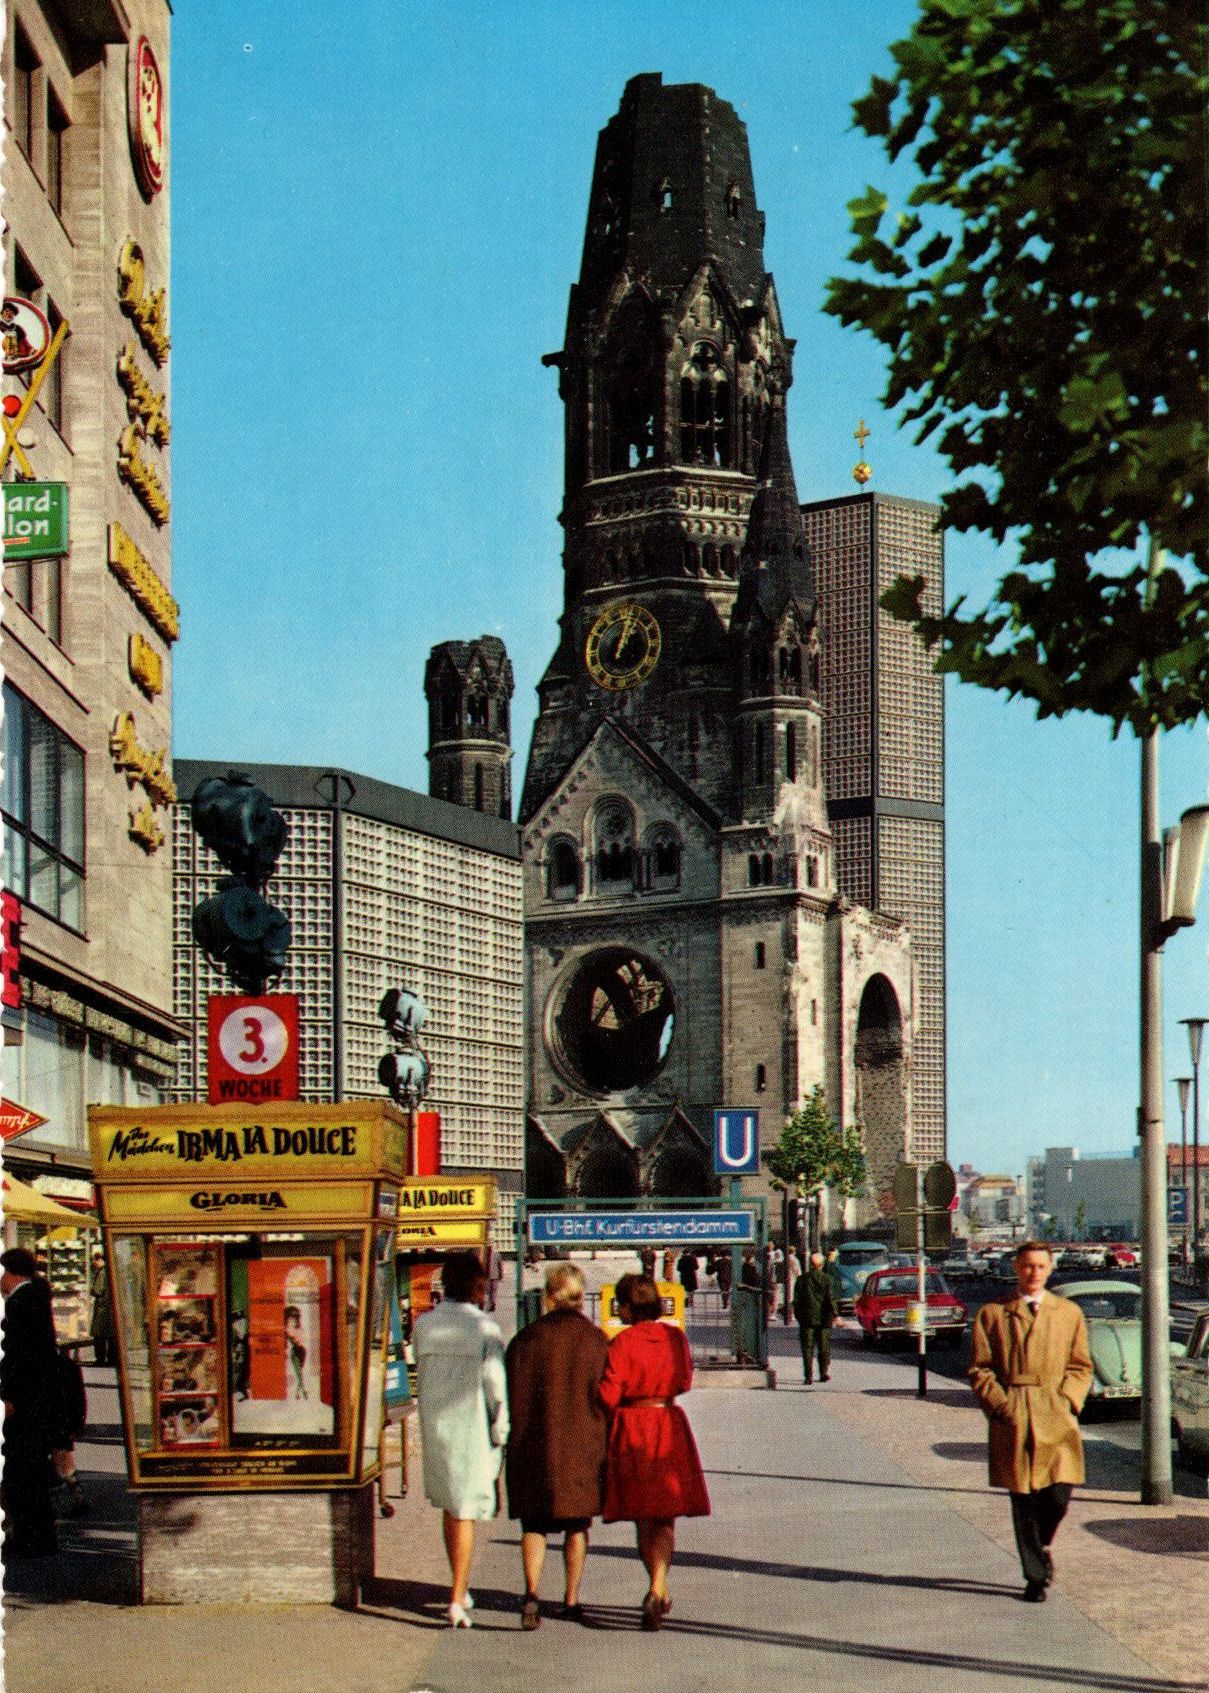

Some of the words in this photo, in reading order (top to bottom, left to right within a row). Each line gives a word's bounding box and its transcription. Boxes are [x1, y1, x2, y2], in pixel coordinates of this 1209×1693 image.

[239, 1017, 268, 1063] 3.
[219, 1079, 282, 1099] WOCHE
[177, 1128, 243, 1162] IRMA
[242, 1125, 270, 1155] LA
[272, 1126, 357, 1156] DOUCE
[718, 1115, 753, 1168] U
[190, 1190, 288, 1212] GLORIA
